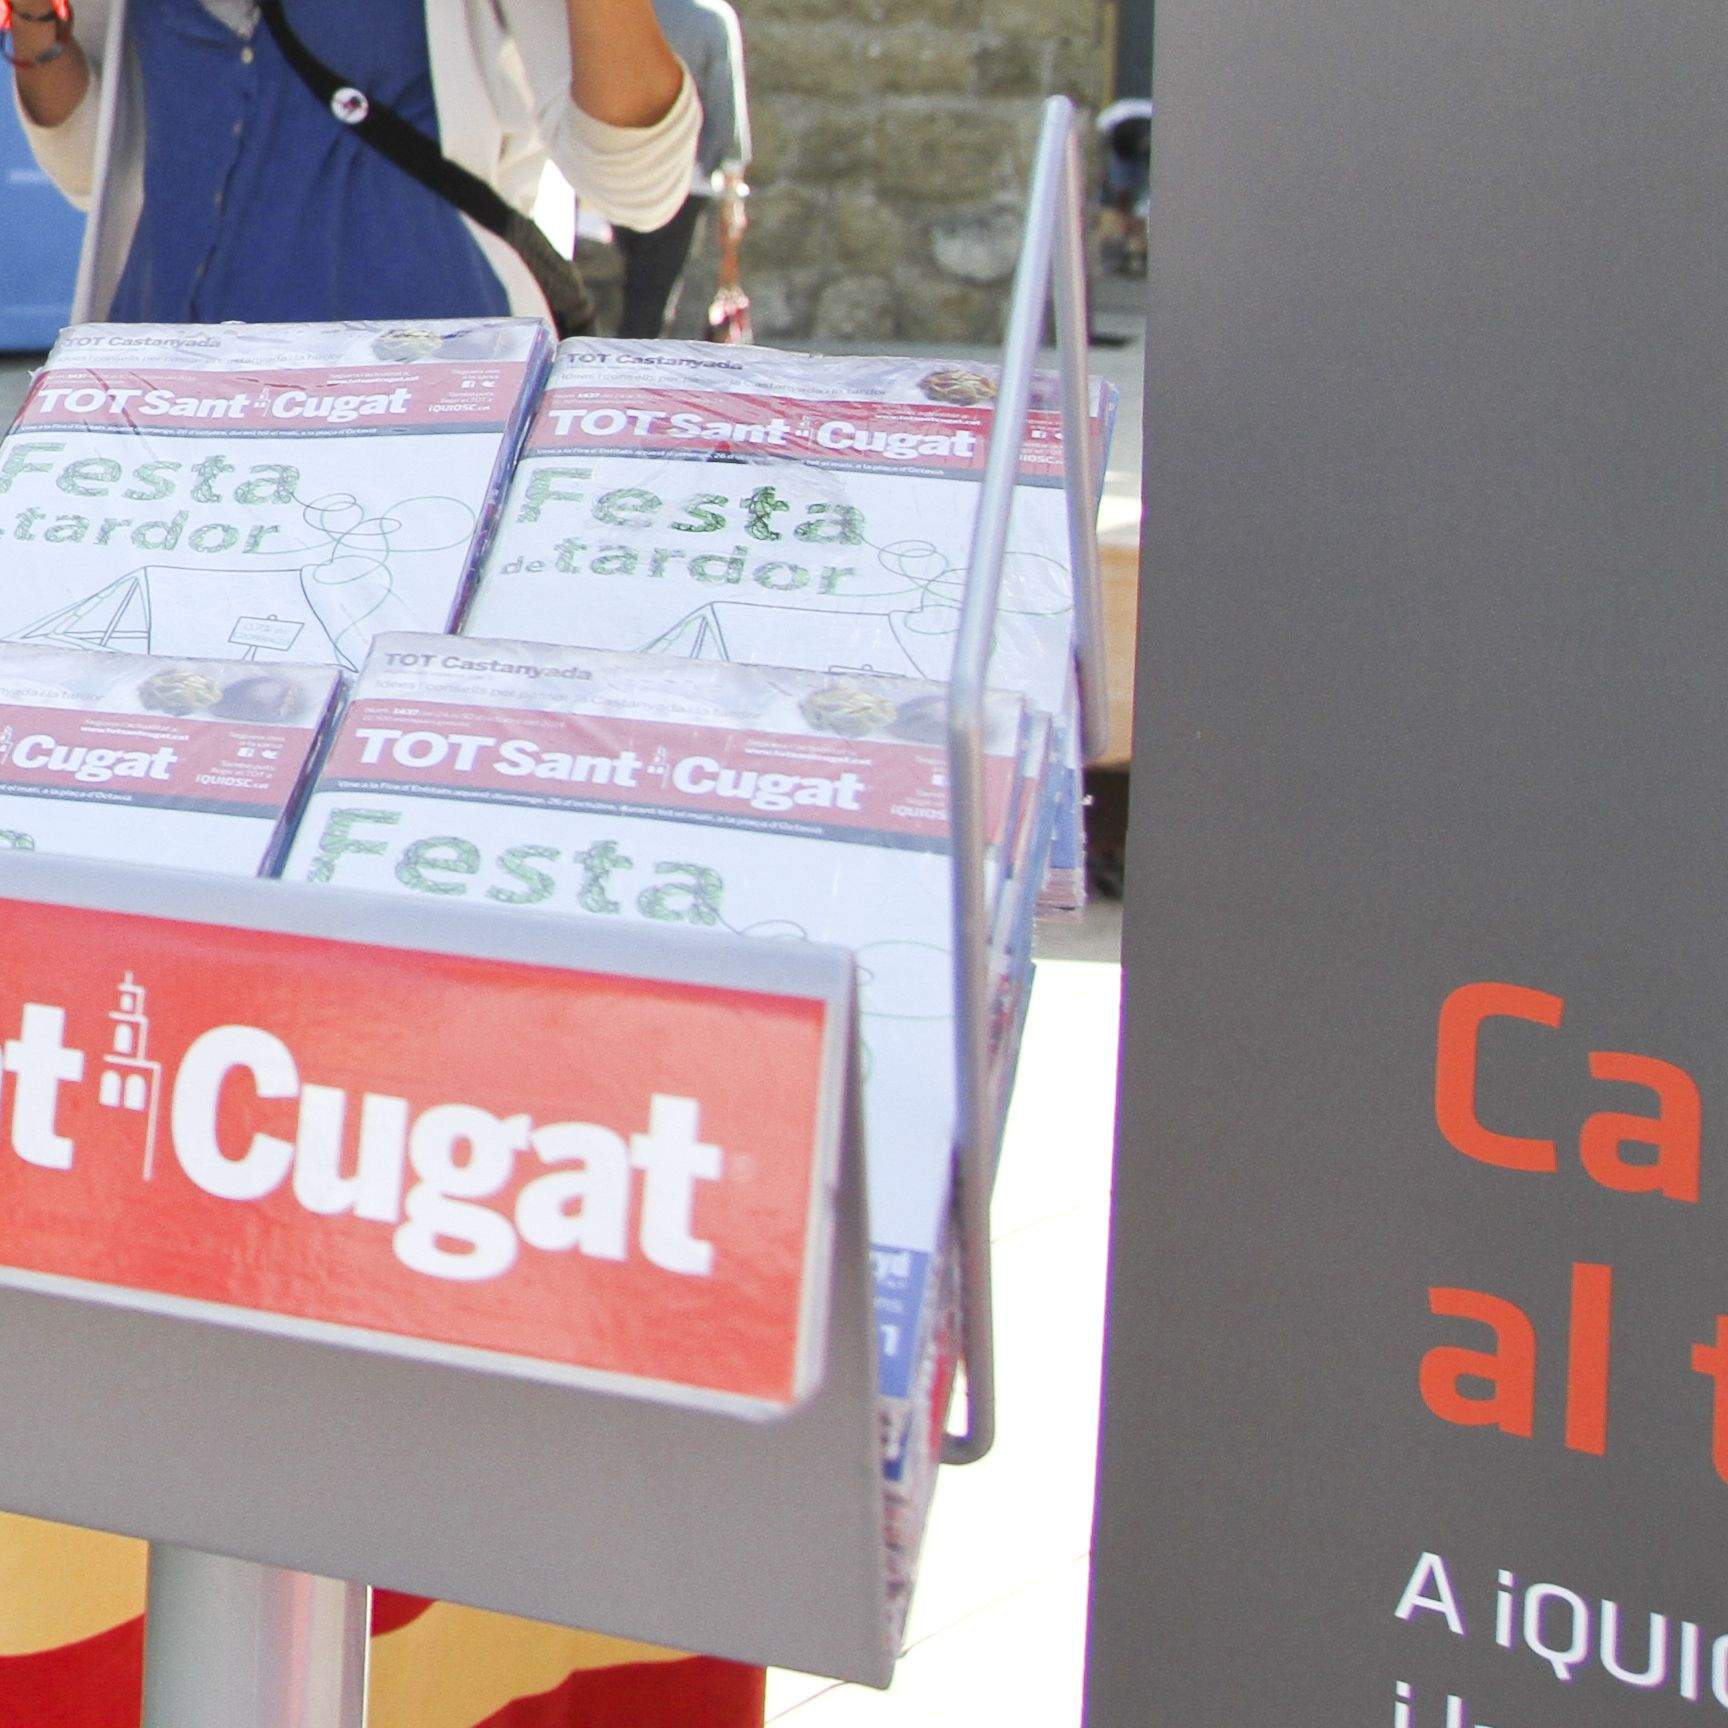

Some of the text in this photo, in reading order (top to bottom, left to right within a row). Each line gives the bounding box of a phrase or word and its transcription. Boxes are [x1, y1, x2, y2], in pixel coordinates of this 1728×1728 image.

[38, 387, 143, 414] TOT
[138, 389, 250, 419] Sant
[272, 387, 412, 423] Cugat
[548, 408, 666, 437] TOT
[667, 413, 791, 445] Sant
[817, 420, 977, 460] Cugat
[13, 507, 280, 554] tardor
[516, 467, 866, 545] Festa
[500, 537, 856, 595] de tardor
[441, 655, 593, 681] Castanyada
[11, 734, 179, 783] Cugat
[355, 728, 497, 772] TOT
[493, 738, 643, 788] Sant
[673, 755, 865, 812] Cugat
[307, 807, 724, 926] Festa
[169, 1024, 721, 1285] Cugat
[1418, 1261, 1613, 1457] al
[1394, 1550, 1728, 1710] A iQUI
